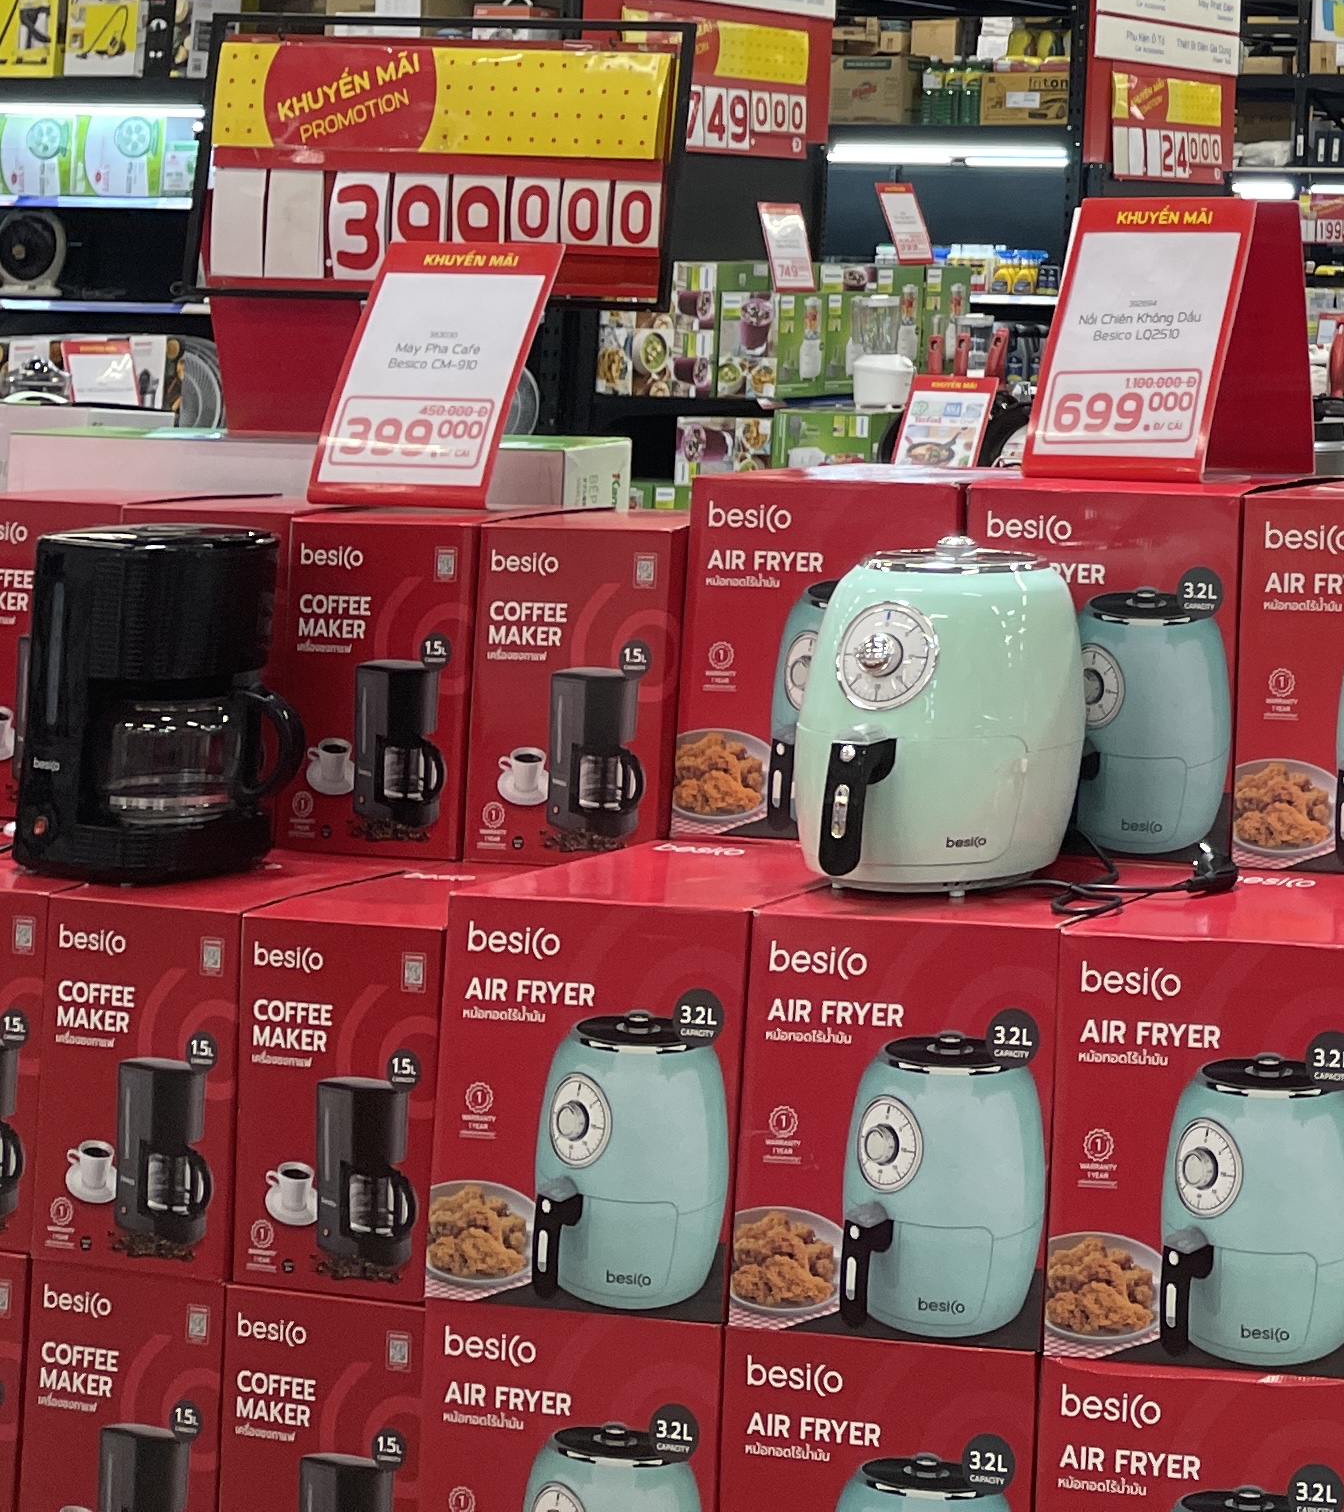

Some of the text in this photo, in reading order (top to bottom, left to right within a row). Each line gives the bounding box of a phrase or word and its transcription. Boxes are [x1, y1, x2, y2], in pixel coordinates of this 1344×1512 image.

[277, 51, 421, 123] KHUYẾN MÃI
[298, 87, 411, 145] PROMOTION
[1116, 204, 1214, 225] KHUYẾN MÃI
[488, 253, 520, 267] MÃI
[1136, 311, 1174, 328] Không
[1093, 327, 1181, 342] Besico LQ2510
[430, 358, 478, 371] CM-910
[708, 500, 792, 534] besico
[986, 510, 1072, 542] besico
[300, 543, 364, 569] besico
[491, 549, 559, 576] besico
[707, 549, 825, 574] AIR FRYER
[1182, 581, 1218, 602] 3.2L
[1264, 570, 1306, 594] AIR
[299, 593, 372, 617] COFFEE
[489, 600, 568, 625] COFFEE
[298, 617, 367, 640] MAKER
[487, 624, 562, 648] MAKER
[1121, 818, 1163, 835] besico
[945, 834, 988, 851] besico
[58, 923, 127, 956] besico
[467, 921, 561, 960] besico
[253, 941, 324, 974] besico
[768, 940, 868, 981] besico
[465, 977, 595, 1008] AIR FRYER
[1080, 960, 1182, 1002] besico
[57, 980, 136, 1009] COFFEE
[56, 1005, 130, 1034] MAKER
[679, 1005, 717, 1026] 3.2L
[767, 997, 905, 1028] AIR FRYER
[1080, 1018, 1222, 1050] AIR FRYER
